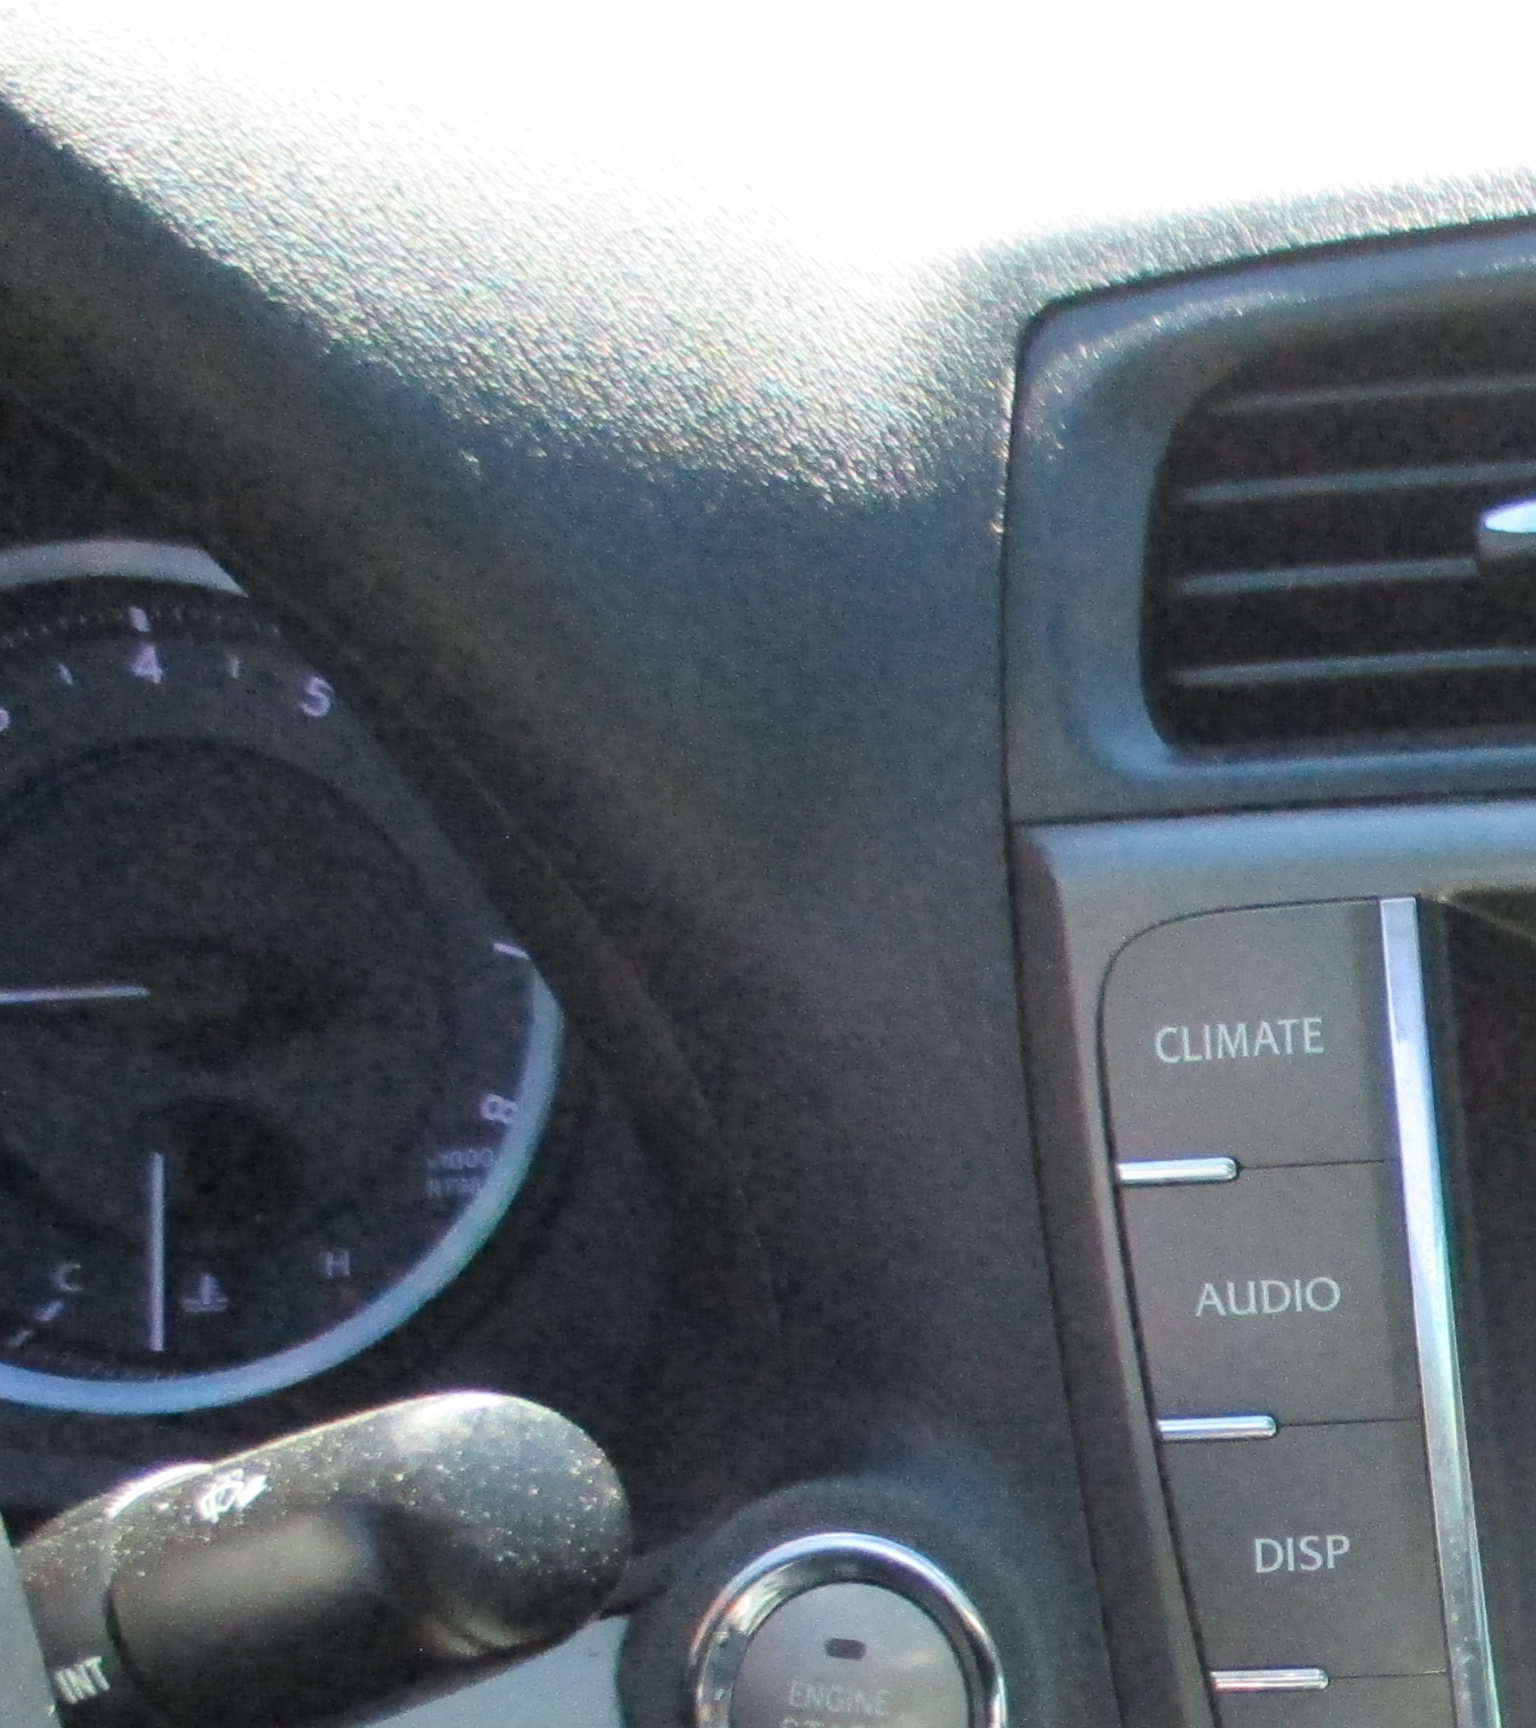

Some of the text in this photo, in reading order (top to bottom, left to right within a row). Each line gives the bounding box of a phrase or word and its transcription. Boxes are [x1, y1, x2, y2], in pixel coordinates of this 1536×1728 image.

[300, 675, 334, 718] 5
[1154, 1017, 1326, 1064] CLIMATE
[1196, 1276, 1342, 1318] AUDIO
[1253, 1535, 1351, 1574] DISP
[786, 1680, 892, 1716] ENGINE
